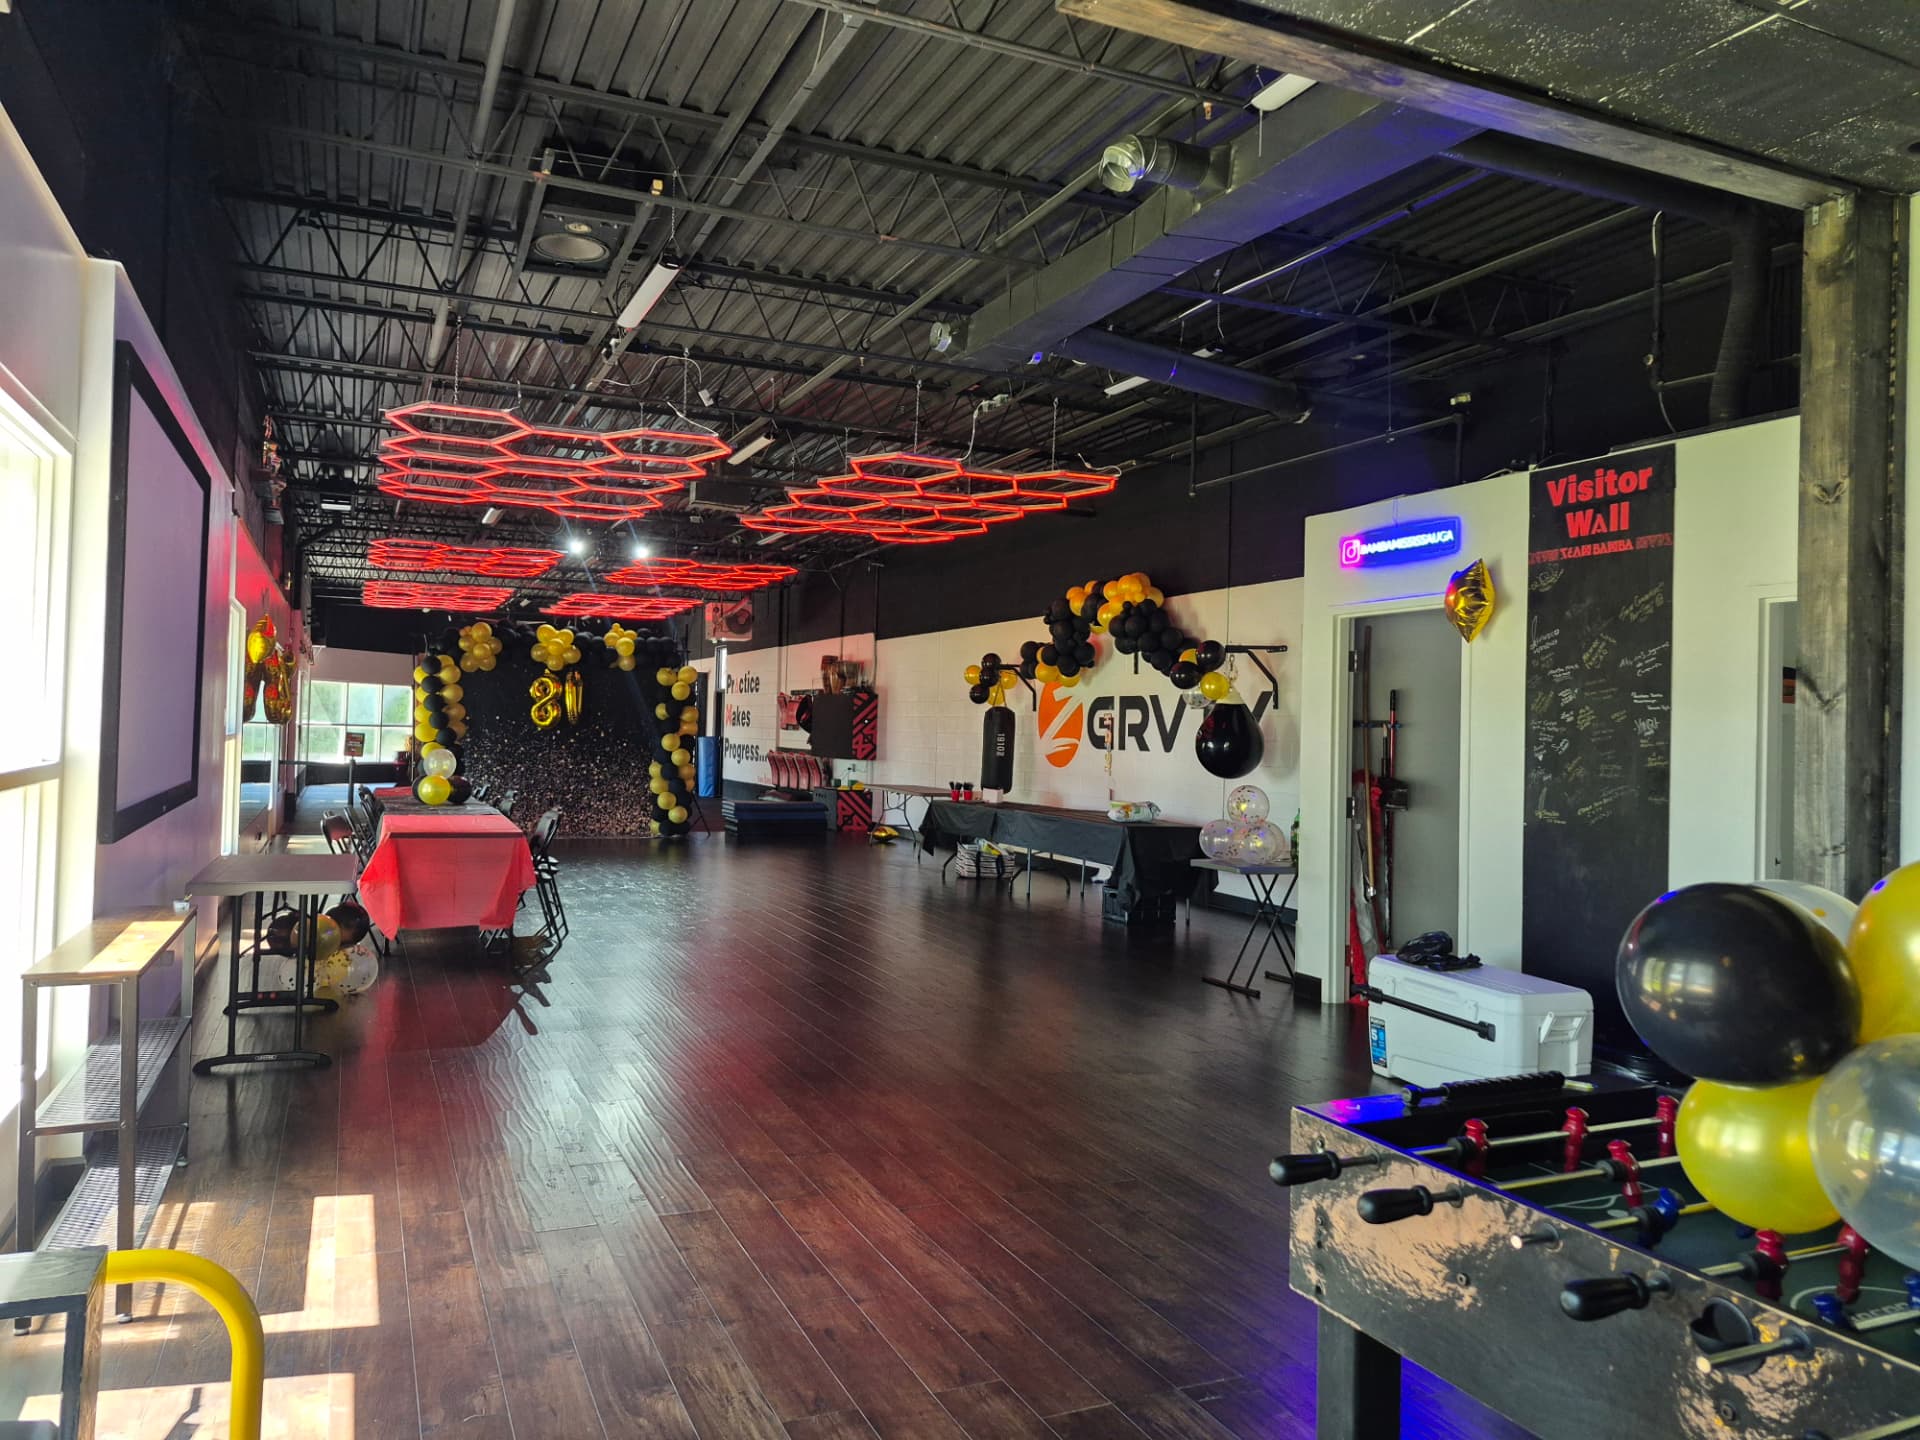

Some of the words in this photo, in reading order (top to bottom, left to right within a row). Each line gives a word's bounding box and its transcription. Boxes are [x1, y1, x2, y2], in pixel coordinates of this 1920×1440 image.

[1546, 467, 1653, 507] Visitor
[1565, 501, 1631, 539] Wall
[1559, 543, 1593, 561] TEAM
[1593, 538, 1634, 556] BAMBA
[726, 670, 760, 694] Practice
[725, 704, 751, 728] Makes
